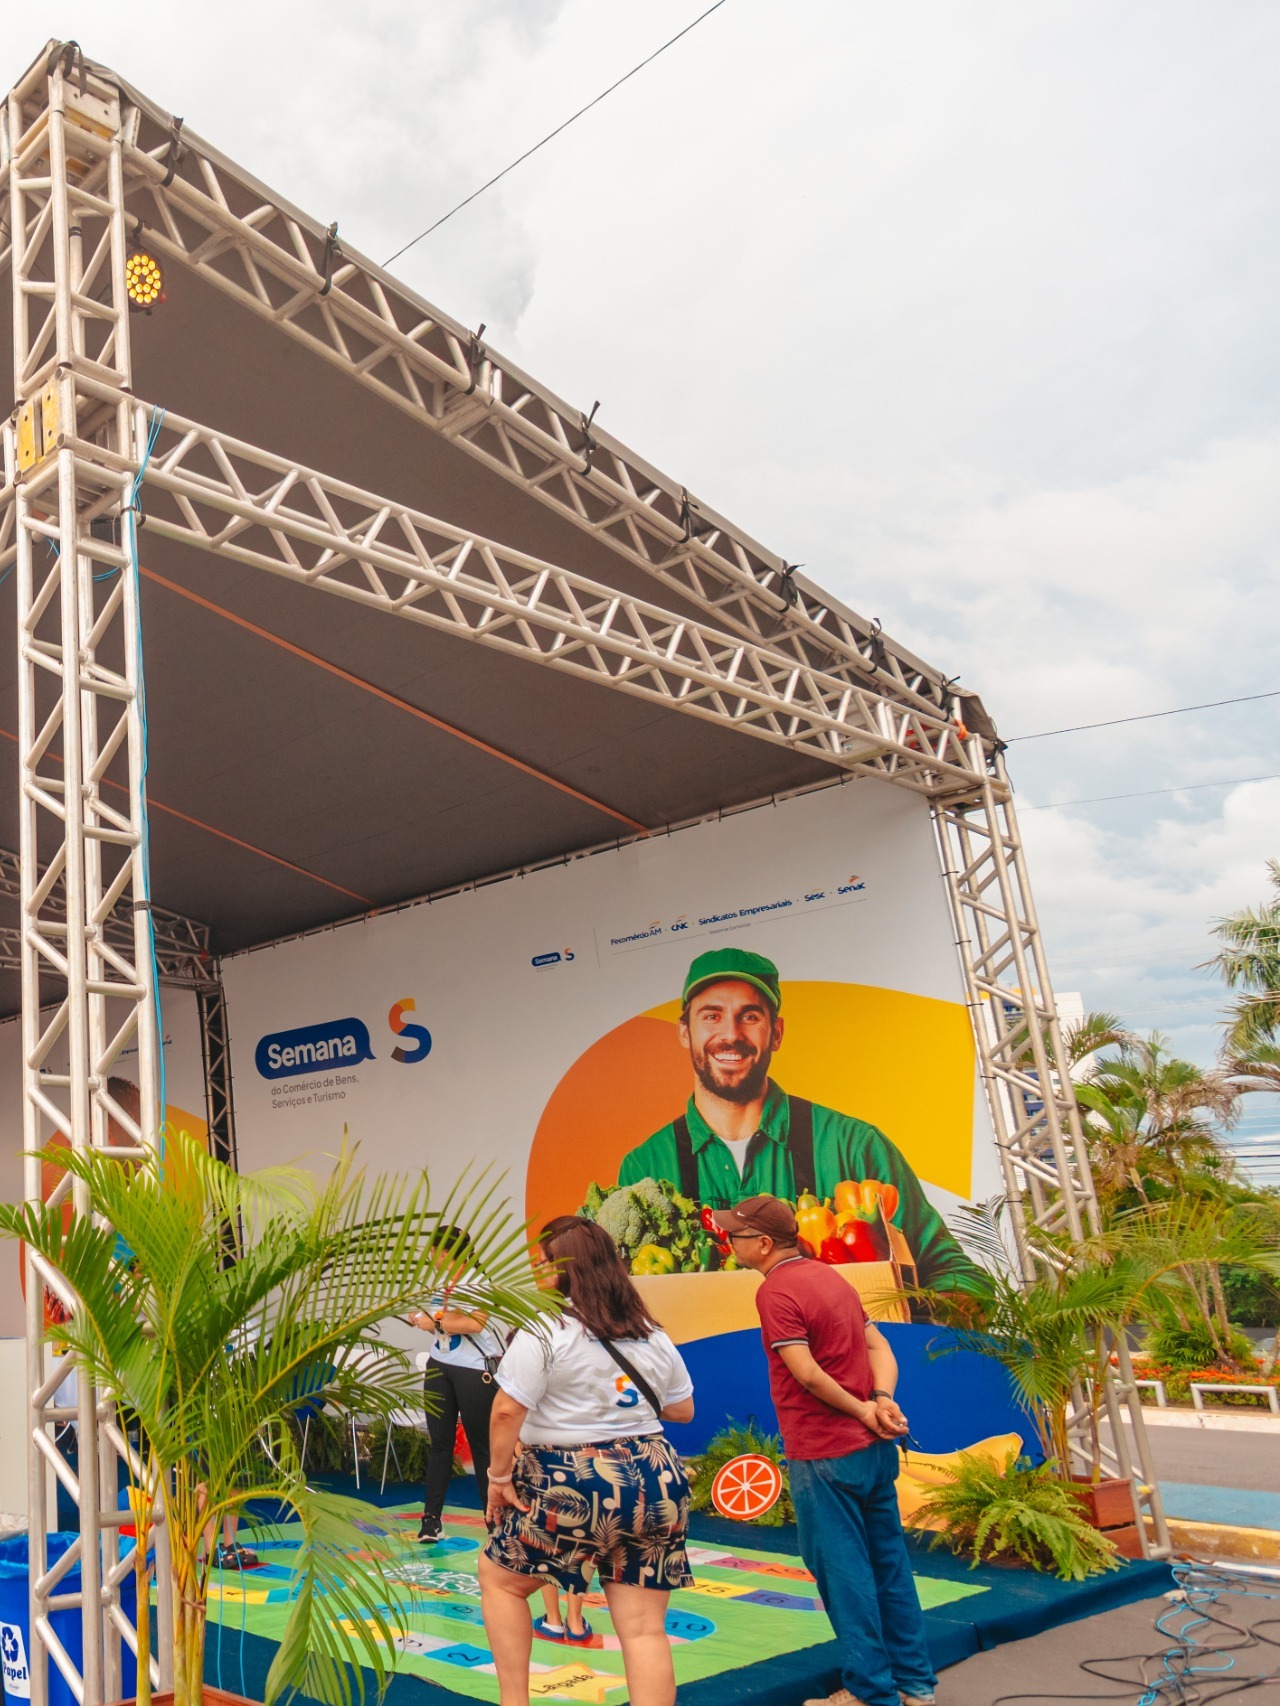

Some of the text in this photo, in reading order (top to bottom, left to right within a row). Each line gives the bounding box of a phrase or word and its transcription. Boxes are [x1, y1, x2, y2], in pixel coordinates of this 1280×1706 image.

[671, 922, 688, 932] CNC
[698, 912, 738, 926] Sindicatos
[739, 900, 792, 917] Empresariais
[388, 998, 432, 1064] S
[268, 1035, 357, 1070] Semana
[271, 1085, 282, 1096] do
[282, 1079, 322, 1094] Comércio
[323, 1077, 334, 1088] de
[272, 1090, 346, 1109] Serviços e Turismo
[695, 1584, 731, 1594] 15
[751, 1593, 790, 1604] 16
[671, 1621, 707, 1632] 10
[447, 1652, 481, 1662] 2
[3, 1661, 27, 1681] Papel
